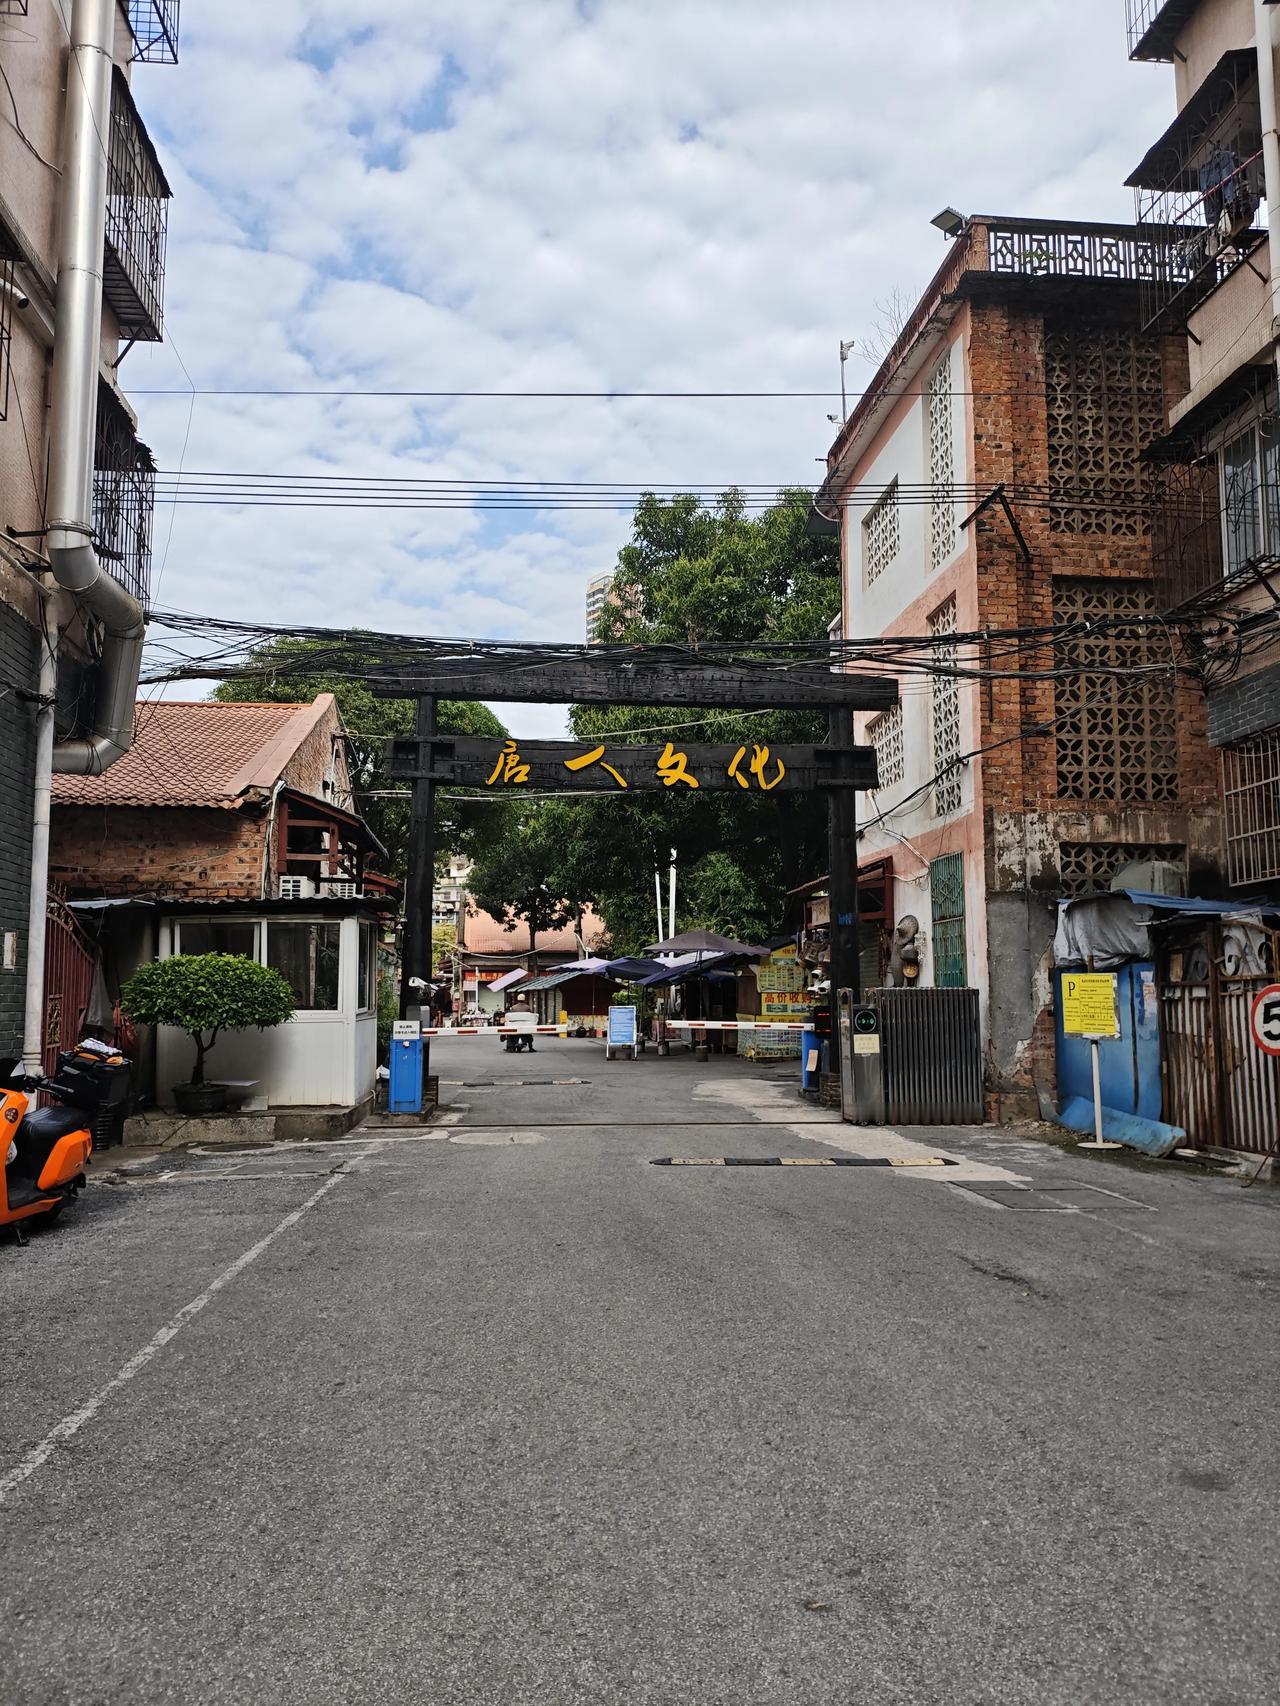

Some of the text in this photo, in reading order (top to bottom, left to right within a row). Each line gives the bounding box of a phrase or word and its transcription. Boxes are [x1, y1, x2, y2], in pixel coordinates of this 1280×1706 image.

[486, 740, 785, 790] 唐人文化
[1068, 981, 1076, 997] P
